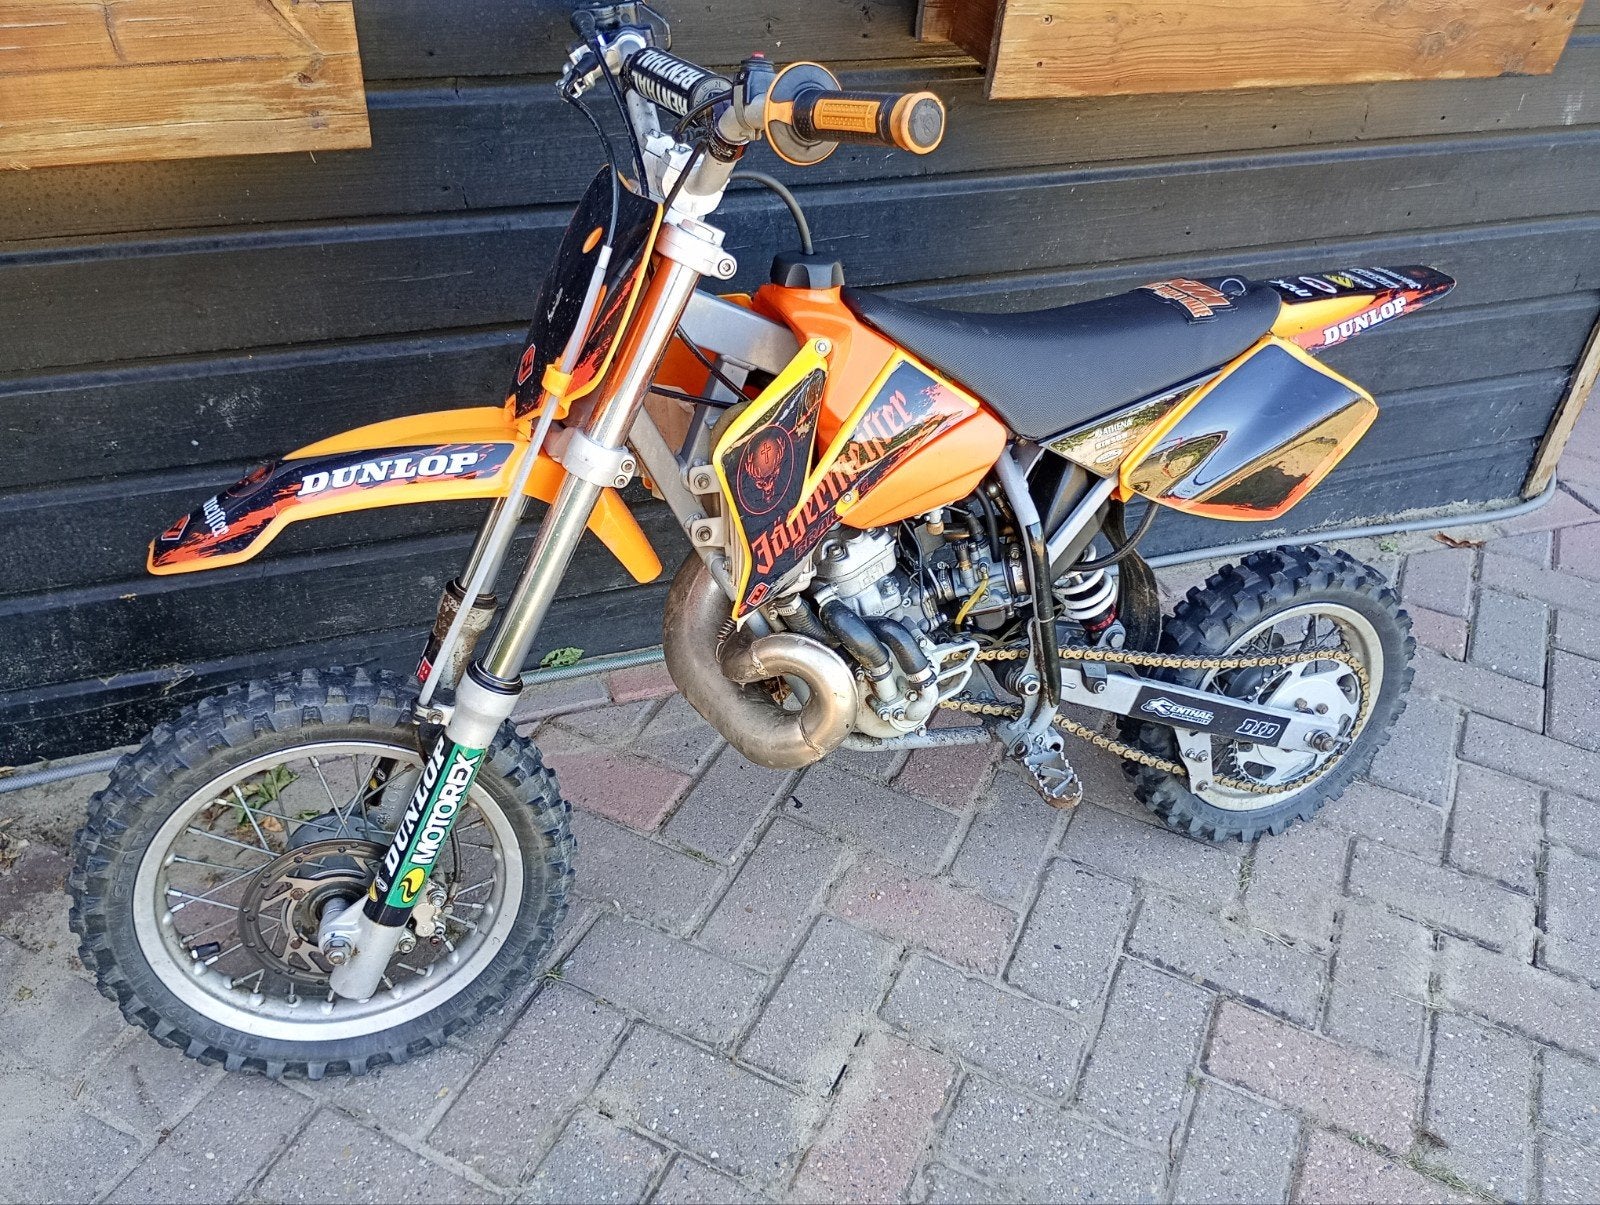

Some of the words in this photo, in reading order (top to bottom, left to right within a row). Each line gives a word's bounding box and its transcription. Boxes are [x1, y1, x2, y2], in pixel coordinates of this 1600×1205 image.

[631, 69, 688, 116] RENTHAL
[637, 48, 706, 91] RENTHAL
[1323, 297, 1407, 346] DUNLOP
[1104, 418, 1133, 436] ATHENA
[297, 451, 479, 497] DUNLOP
[384, 735, 446, 878] DUNLOP
[410, 749, 481, 865] MOTOREX
